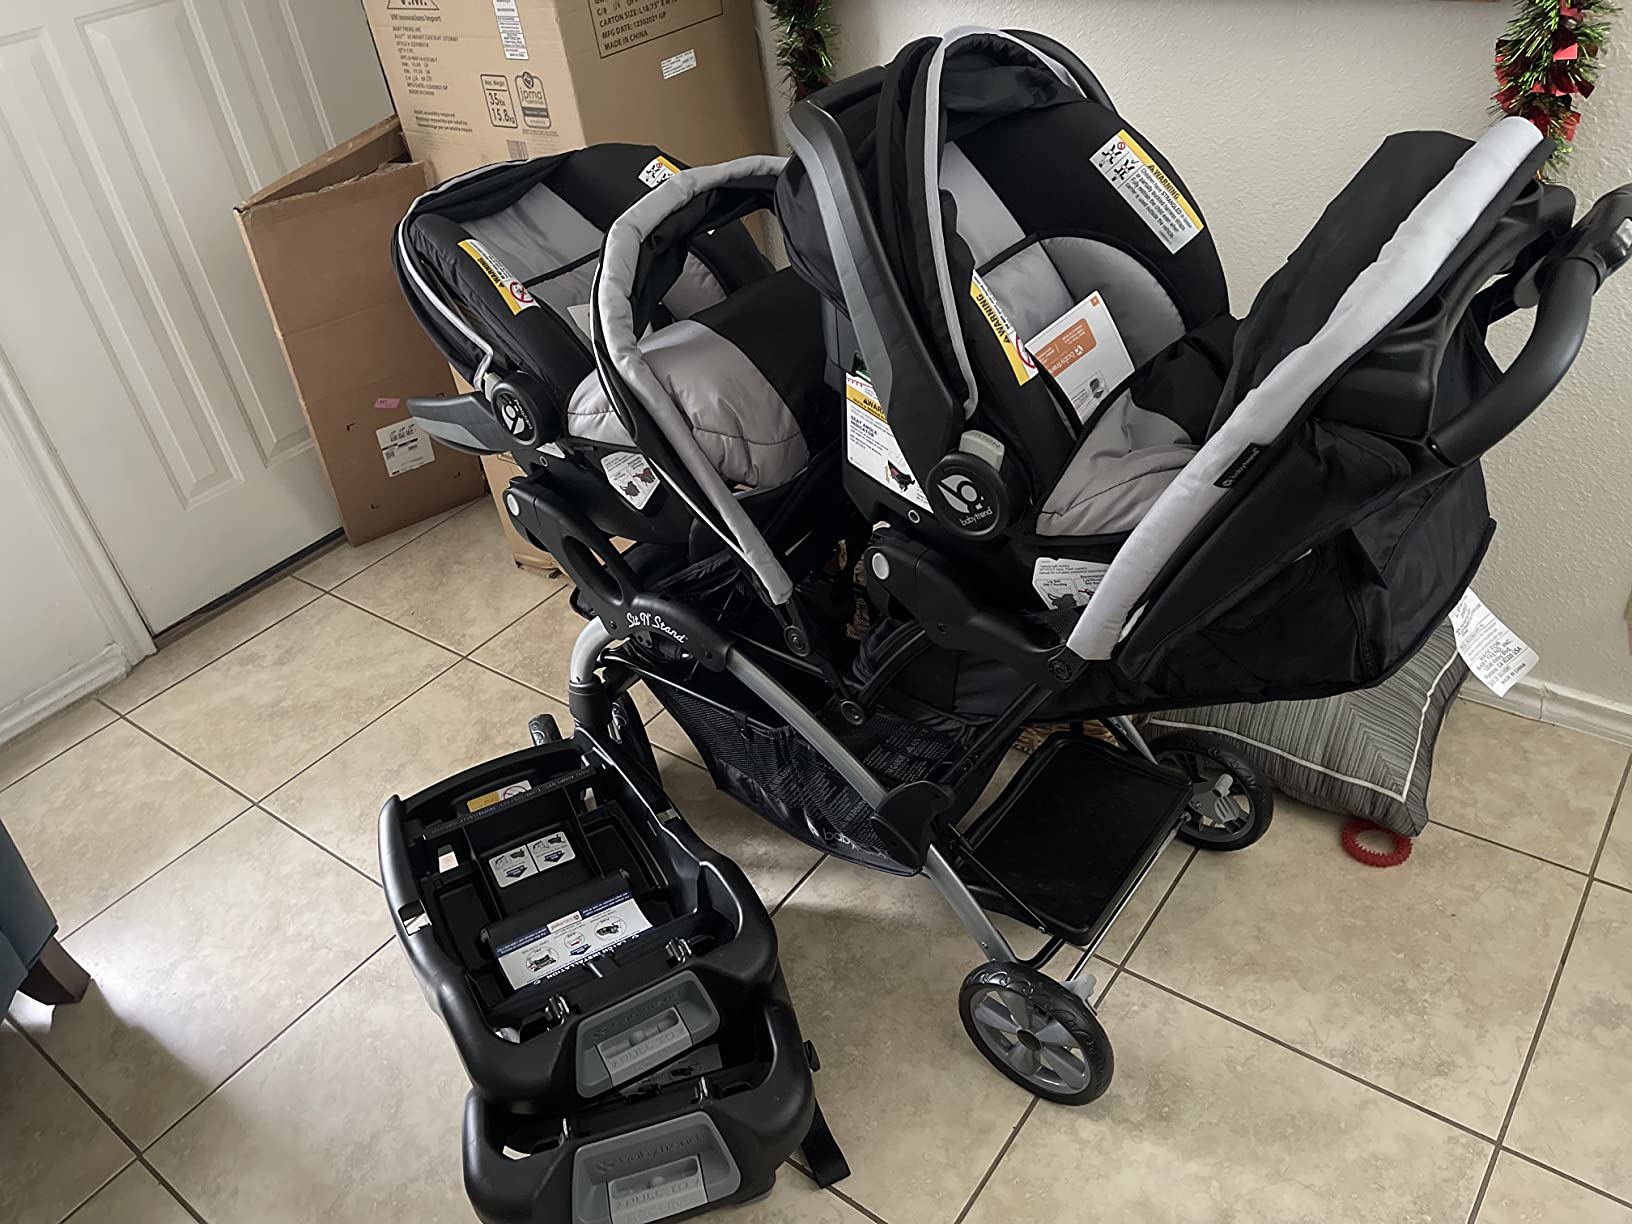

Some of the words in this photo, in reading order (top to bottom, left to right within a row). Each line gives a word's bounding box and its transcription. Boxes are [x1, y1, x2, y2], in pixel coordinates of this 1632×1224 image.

[598, 13, 624, 27] CARTON
[623, 8, 639, 18] SIZE:
[601, 28, 616, 39] MFG
[614, 22, 633, 34] DATE:
[632, 14, 658, 28] 12302021
[603, 38, 622, 50] MADE
[621, 35, 629, 43] IN
[629, 29, 648, 41] CHINA
[519, 87, 542, 101] jpma
[1130, 176, 1140, 187] Fully
[1154, 204, 1164, 215] child
[1140, 167, 1156, 184] Children
[1152, 182, 1163, 193] have
[1160, 190, 1182, 215] STRANGLED
[1152, 168, 1180, 200] WARNING
[1138, 176, 1154, 193] partially
[1151, 190, 1165, 206] buckled
[1162, 204, 1176, 220] harness
[1138, 196, 1148, 207] used
[1156, 218, 1164, 226] the
[477, 254, 500, 285] WARNING
[975, 292, 1006, 336] WARNING
[1046, 350, 1076, 374] babytren
[959, 507, 993, 527] babytrend
[652, 616, 686, 643] Stand
[1489, 640, 1501, 650] FOR
[1496, 661, 1504, 669] CA
[1511, 645, 1522, 655] USA
[1475, 658, 1489, 671] BABY
[1513, 661, 1526, 673] CHINA
[544, 951, 602, 980] INSTALLATION
